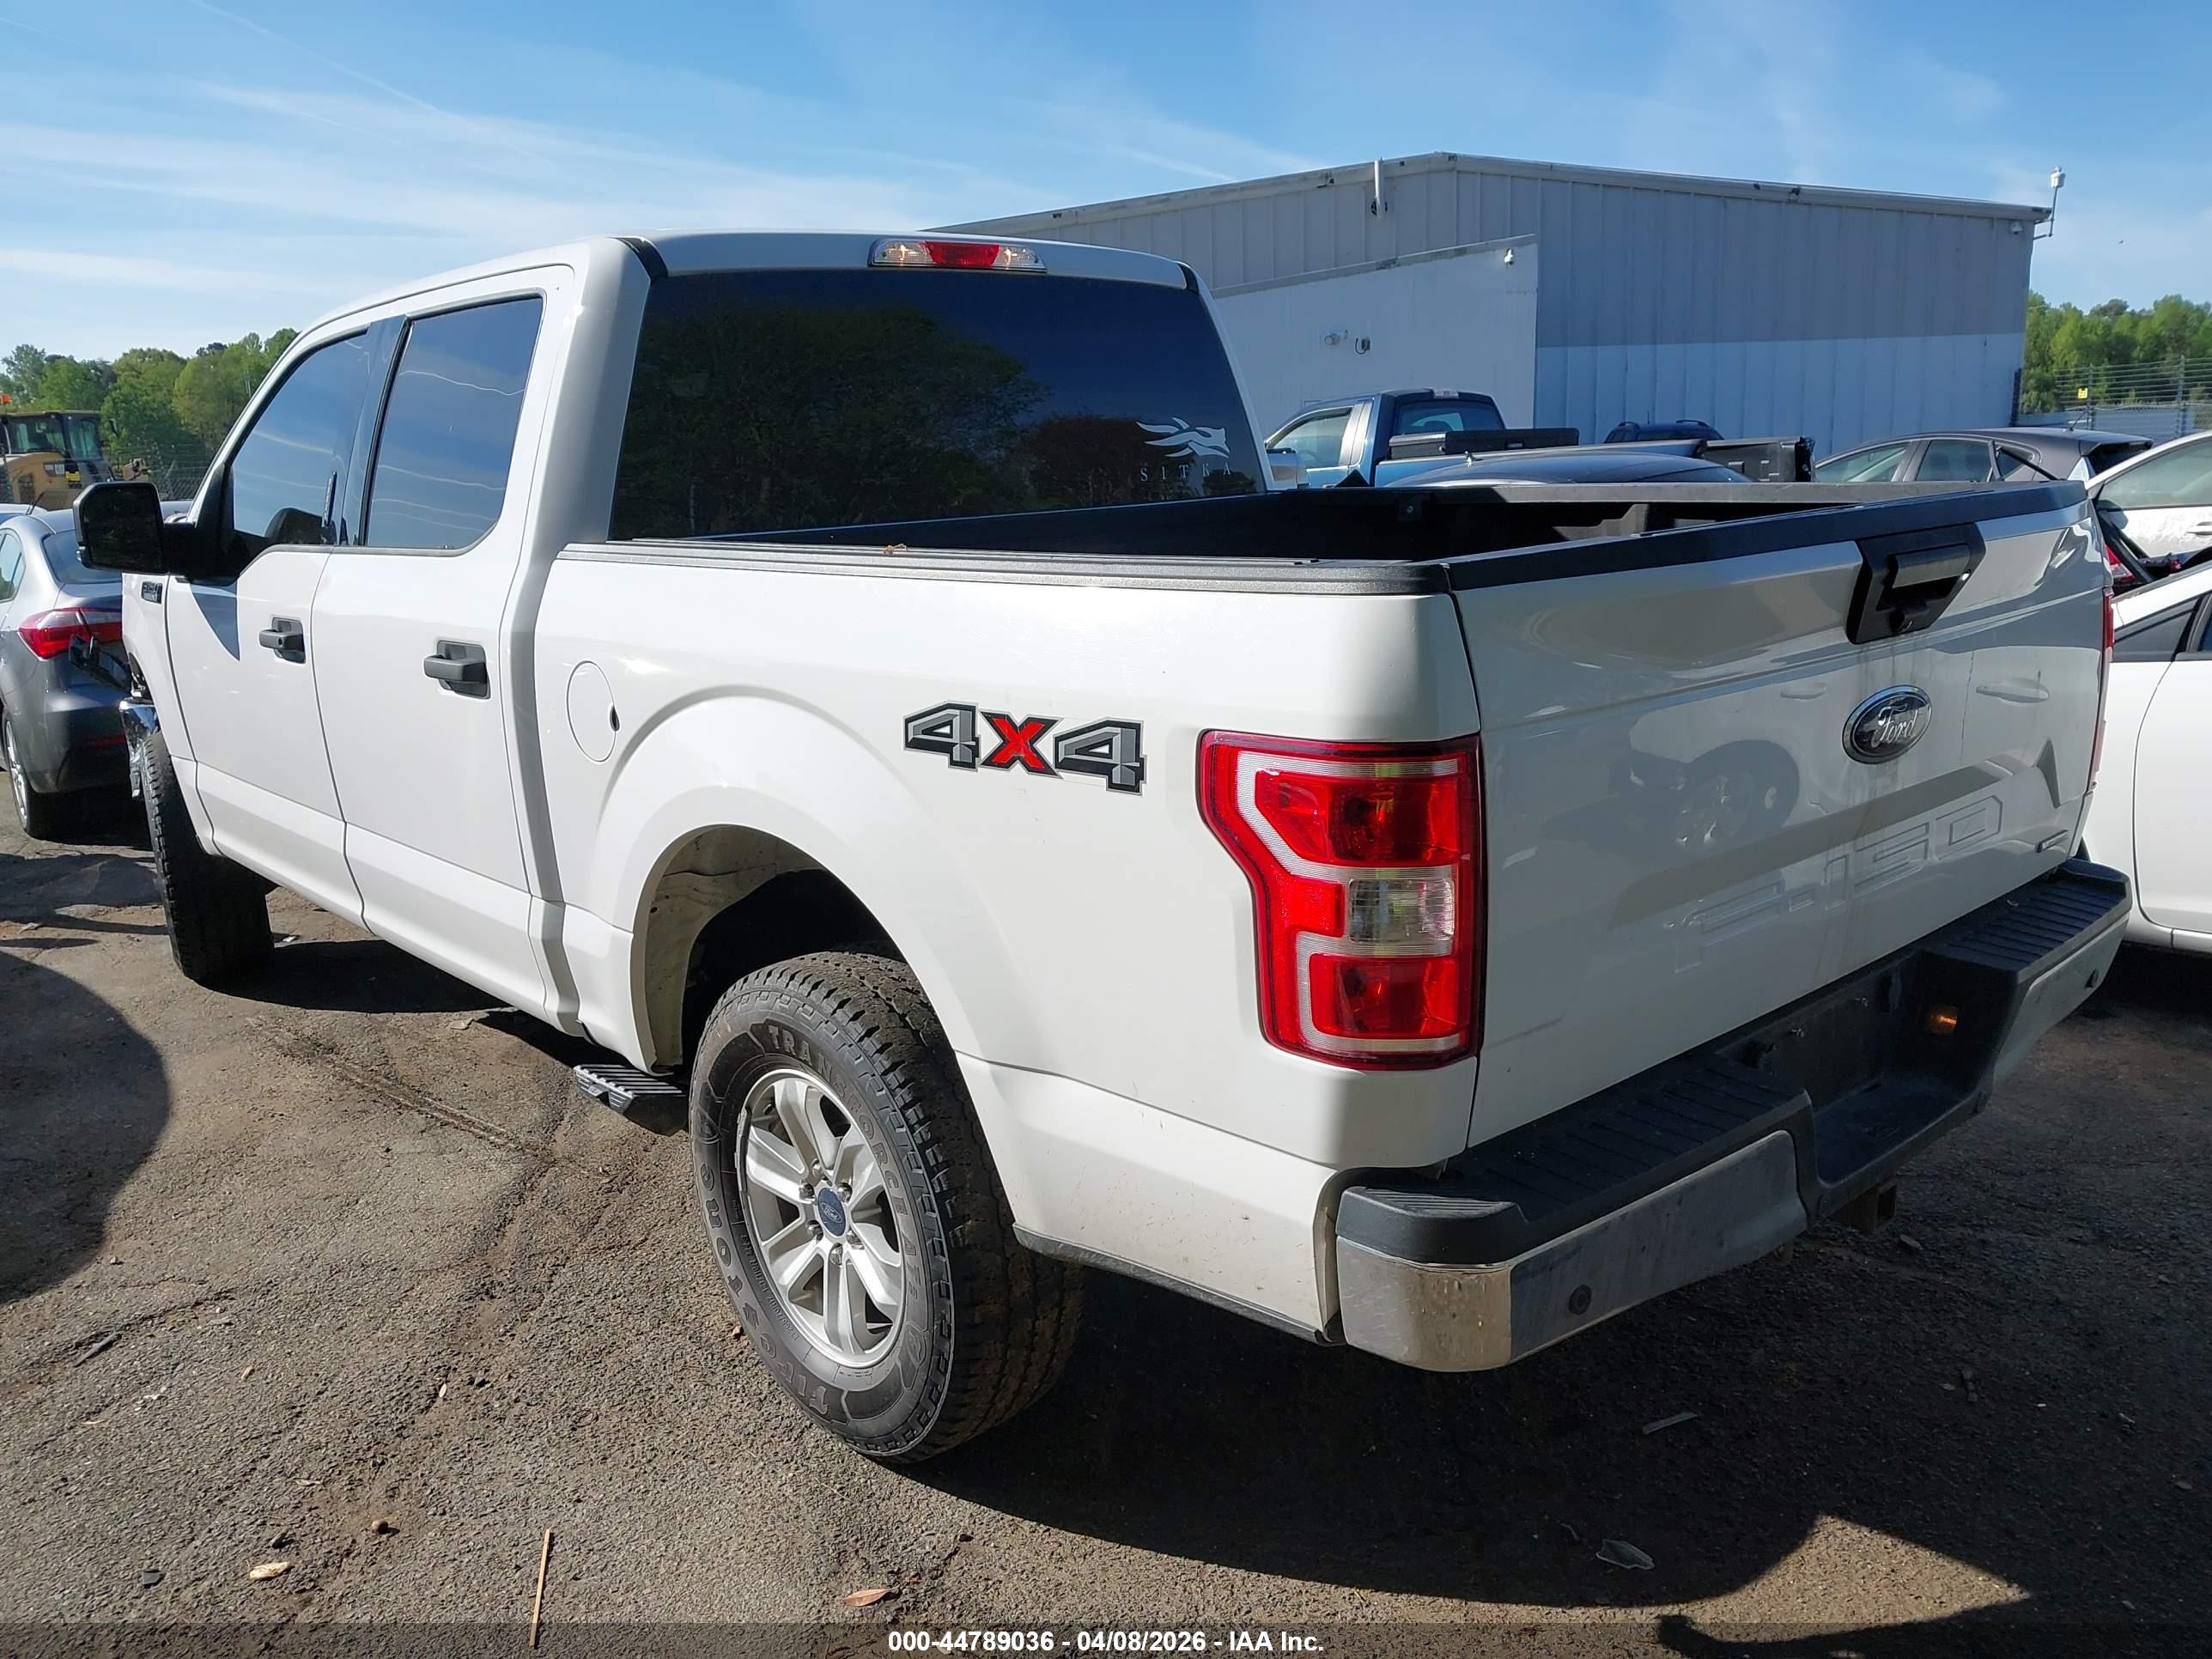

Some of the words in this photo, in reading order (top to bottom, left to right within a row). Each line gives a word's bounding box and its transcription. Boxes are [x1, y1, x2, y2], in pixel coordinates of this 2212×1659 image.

[1139, 460, 1231, 483] SITKA
[1870, 702, 1919, 748] Ford
[1674, 794, 2003, 975] F-150
[768, 1024, 908, 1216] TRANSFORCE
[699, 1161, 829, 1416] Firestone
